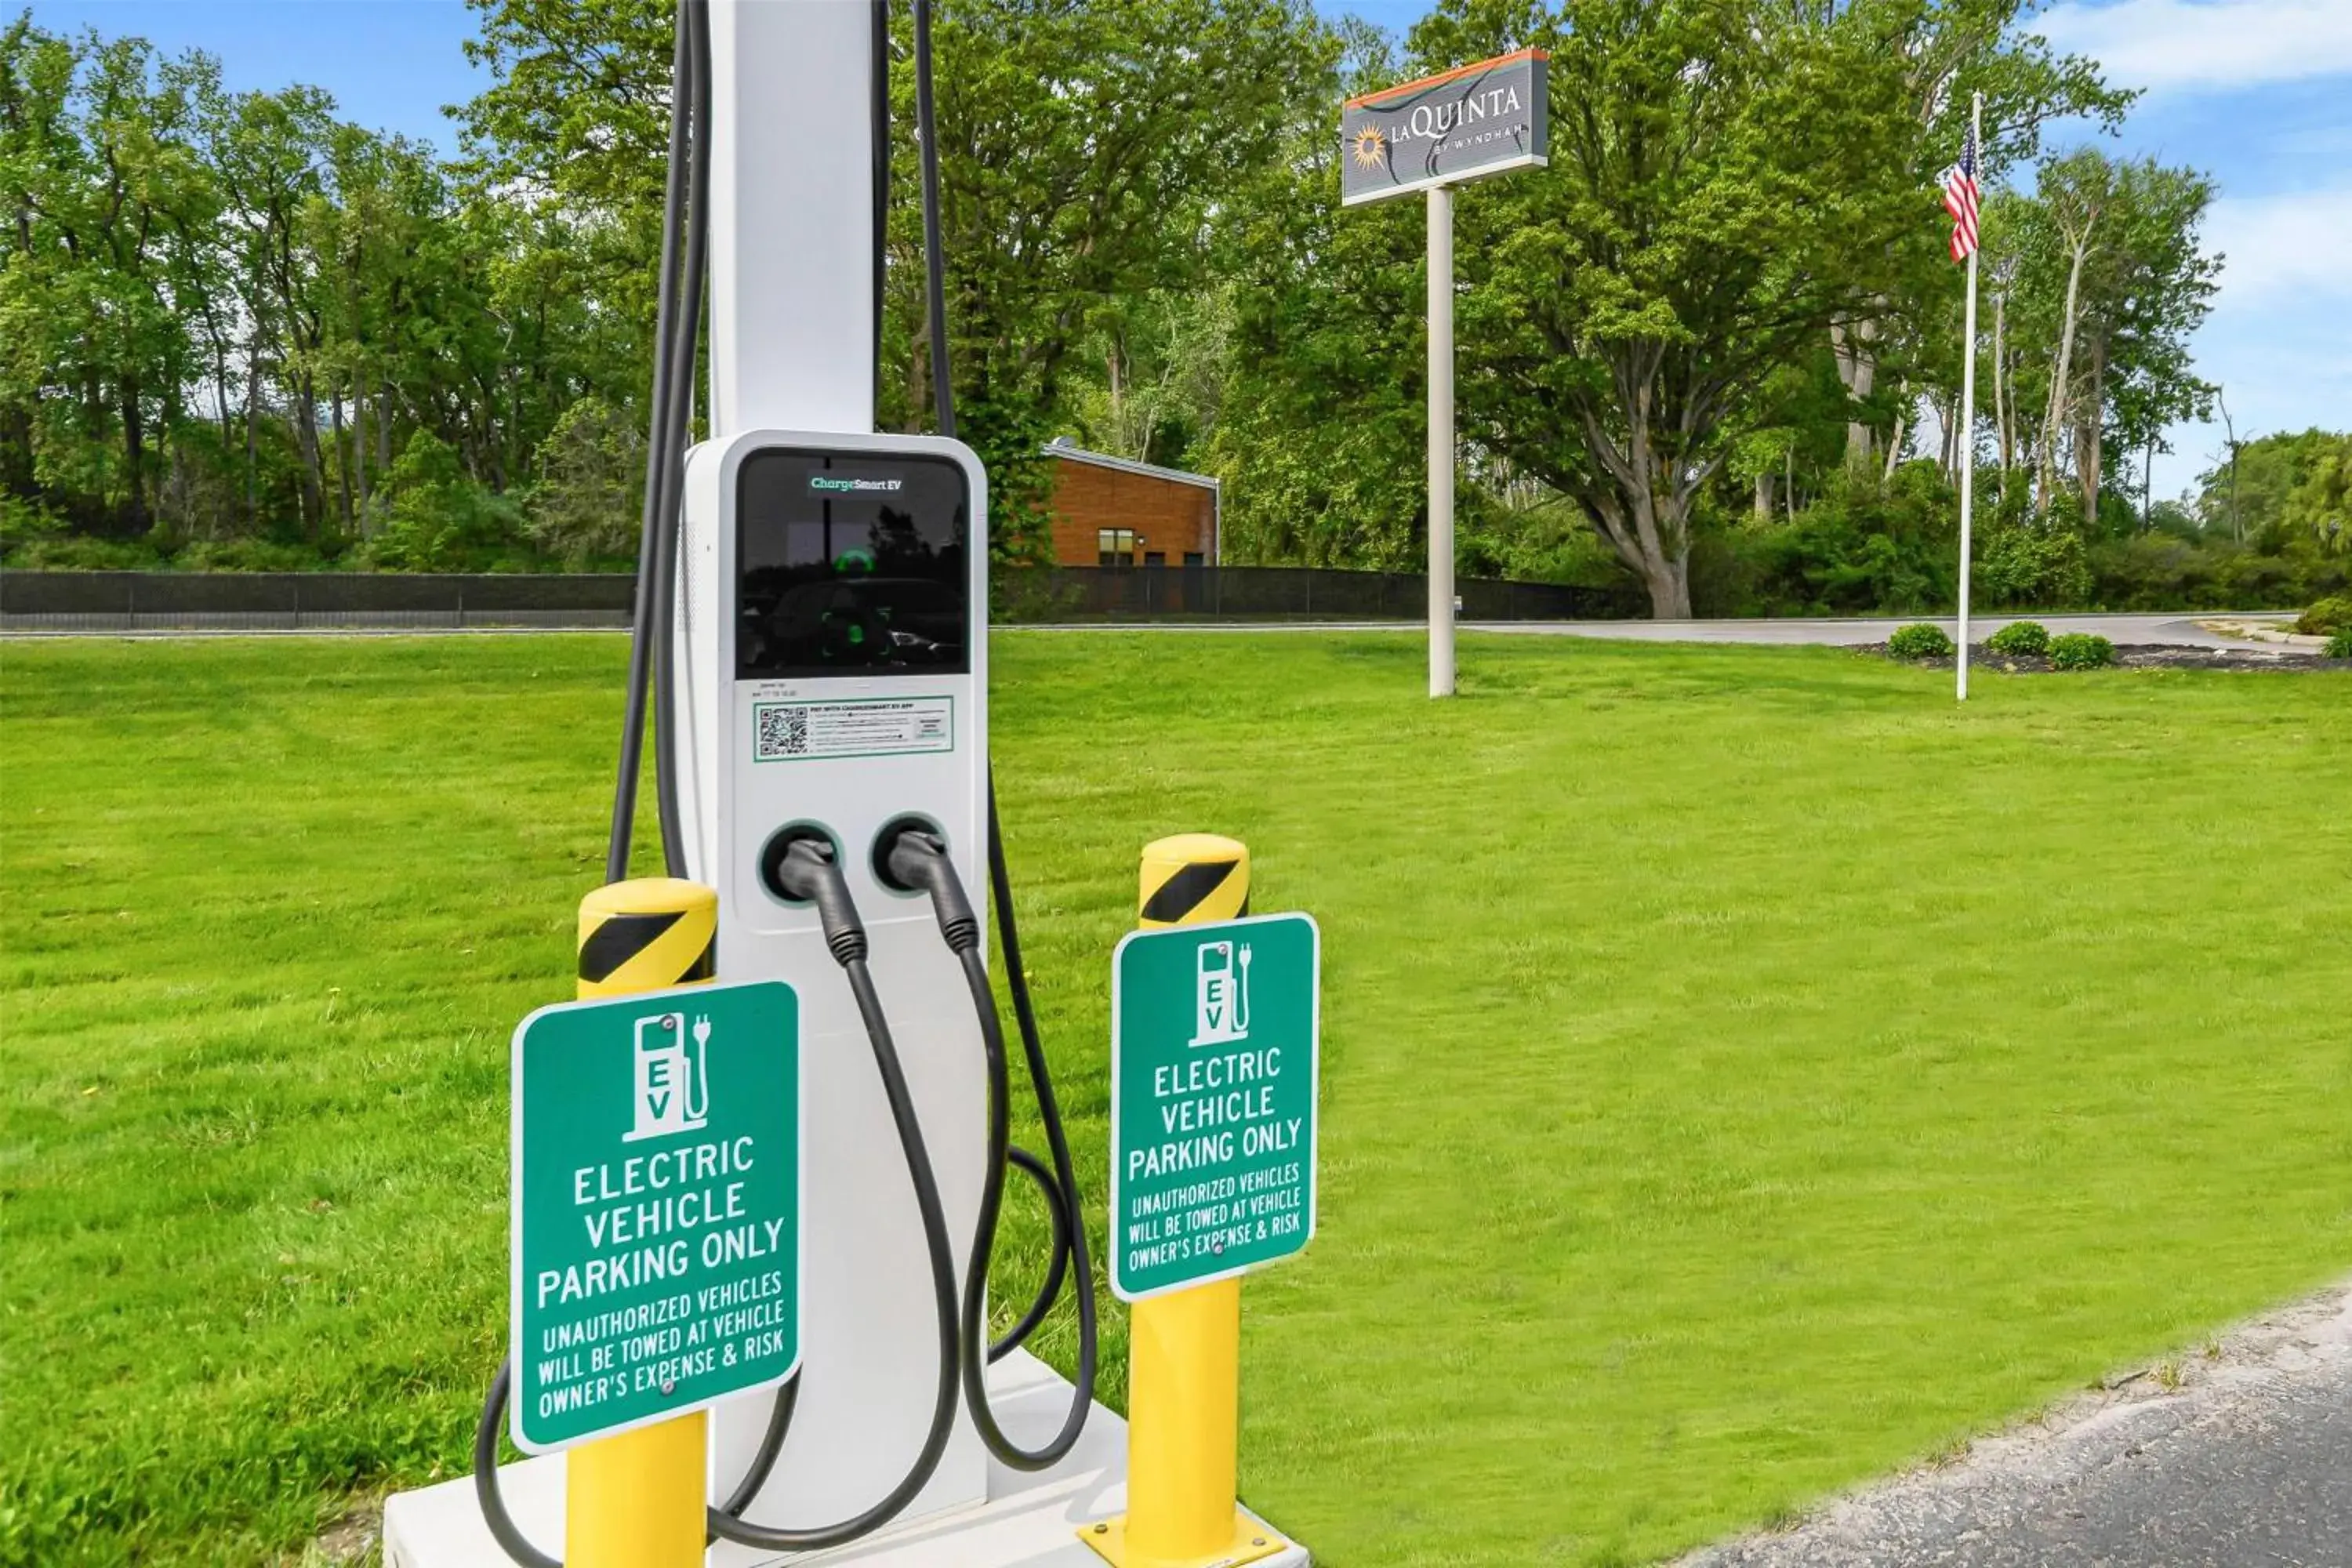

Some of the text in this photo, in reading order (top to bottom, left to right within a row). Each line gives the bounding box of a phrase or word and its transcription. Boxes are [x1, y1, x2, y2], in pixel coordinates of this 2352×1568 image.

[1392, 85, 1521, 143] LA QUINTA
[1454, 124, 1523, 150] WYNDHAM
[887, 480, 902, 490] EV
[1156, 1047, 1279, 1096] ELECTRIC
[1163, 1087, 1273, 1133] VEHICLE
[575, 1137, 753, 1204] ELECTRIC
[1130, 1118, 1301, 1180] PARKING ONLY
[585, 1182, 745, 1247] VEHICLE
[1130, 1188, 1300, 1243] WILL BE TOWED AT VEHICLE
[1133, 1163, 1298, 1217] UNAUTHORIZED VEHICLES
[539, 1218, 783, 1308] PARKING ONLY
[1130, 1213, 1299, 1271] OWNER'S EXPENSE & RISK
[544, 1272, 781, 1352] UNAUTHORIZED VEHICLES
[539, 1300, 783, 1385] WILL BE TOWED AT VEHICLE
[540, 1330, 782, 1417] OWNER'S EXPENSE & RISK
